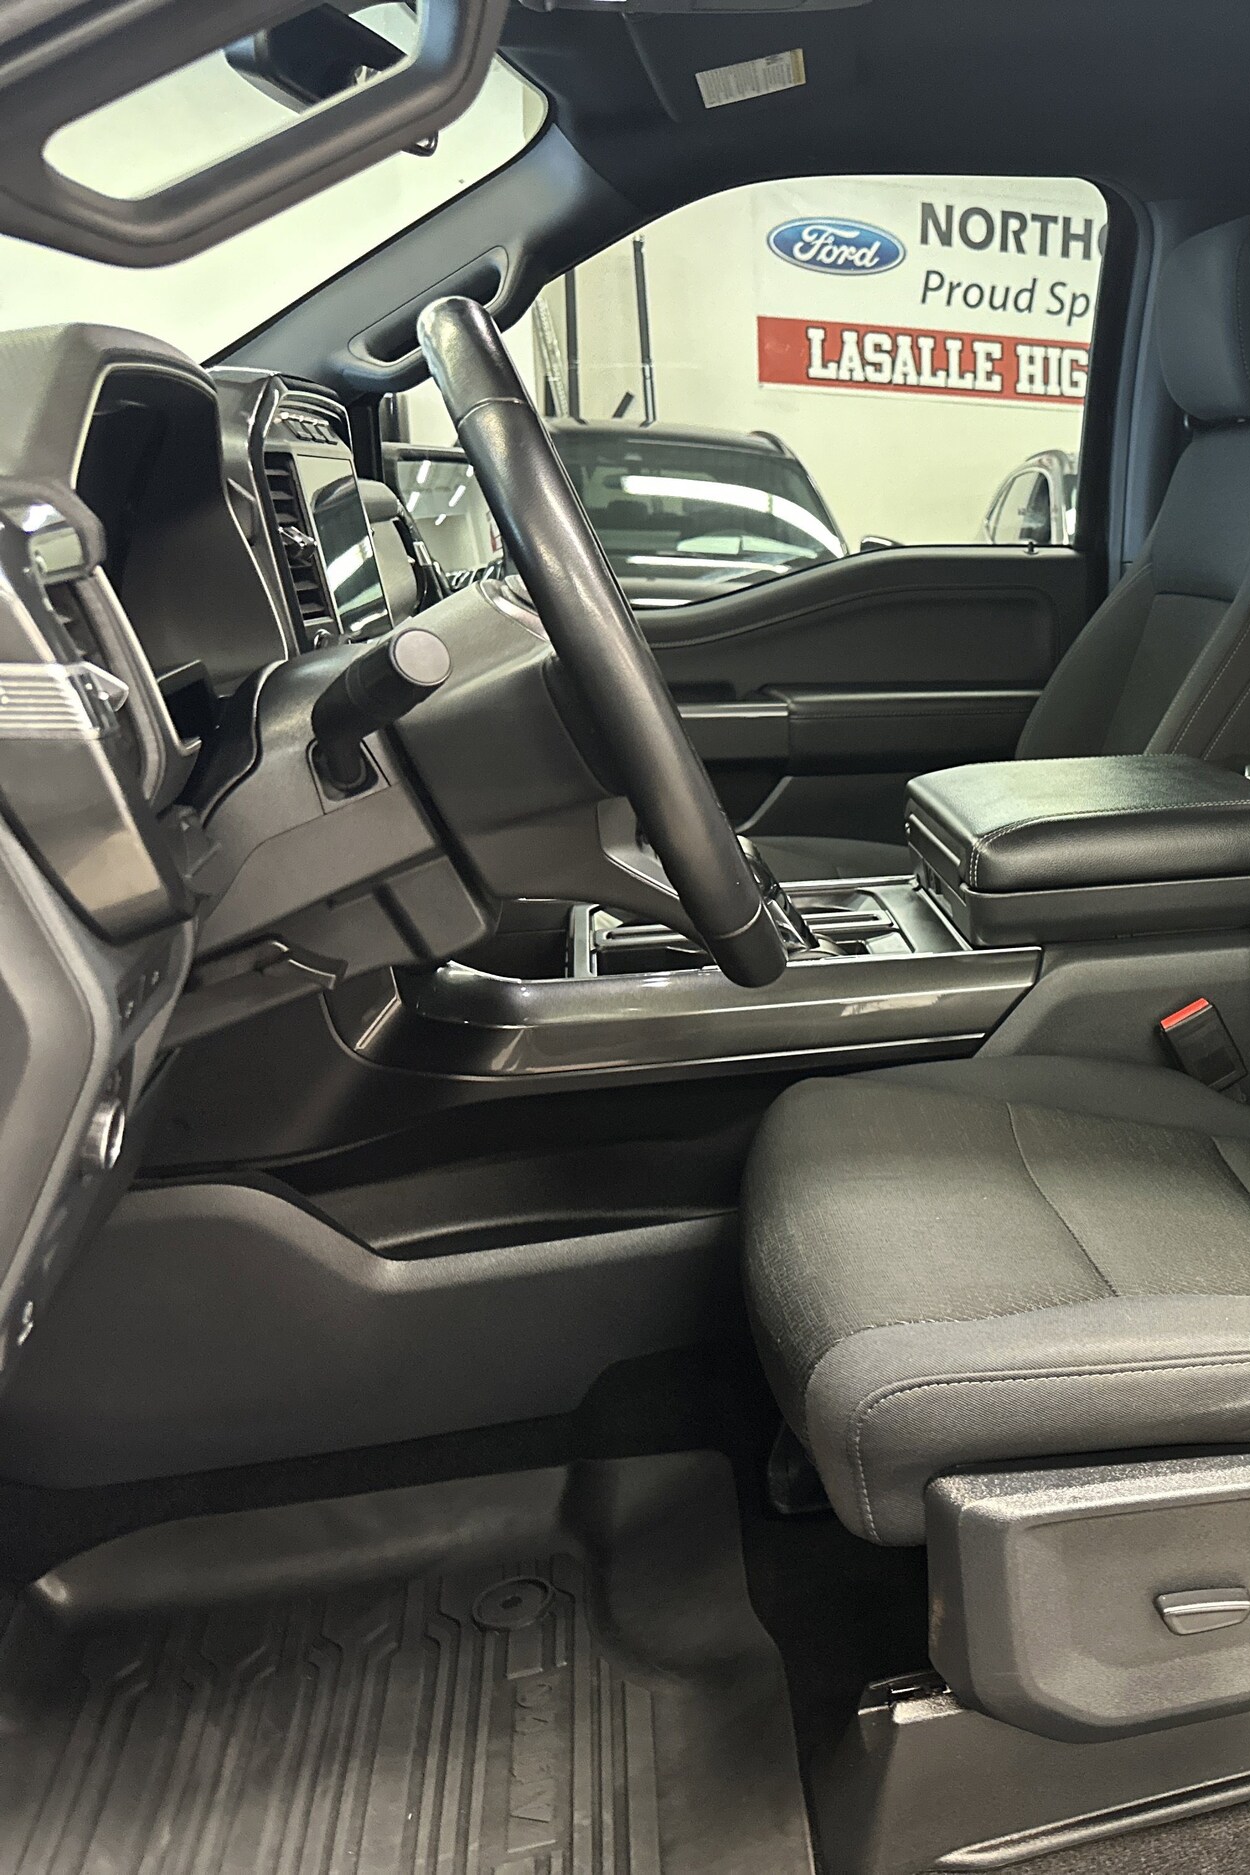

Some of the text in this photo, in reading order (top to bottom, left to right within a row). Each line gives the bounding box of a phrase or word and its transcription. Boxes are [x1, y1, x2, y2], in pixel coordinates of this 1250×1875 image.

[793, 224, 881, 269] Ford
[920, 202, 1108, 261] NORTH
[921, 270, 1096, 327] Proud Sp
[806, 326, 1089, 398] LASALLE HIG
